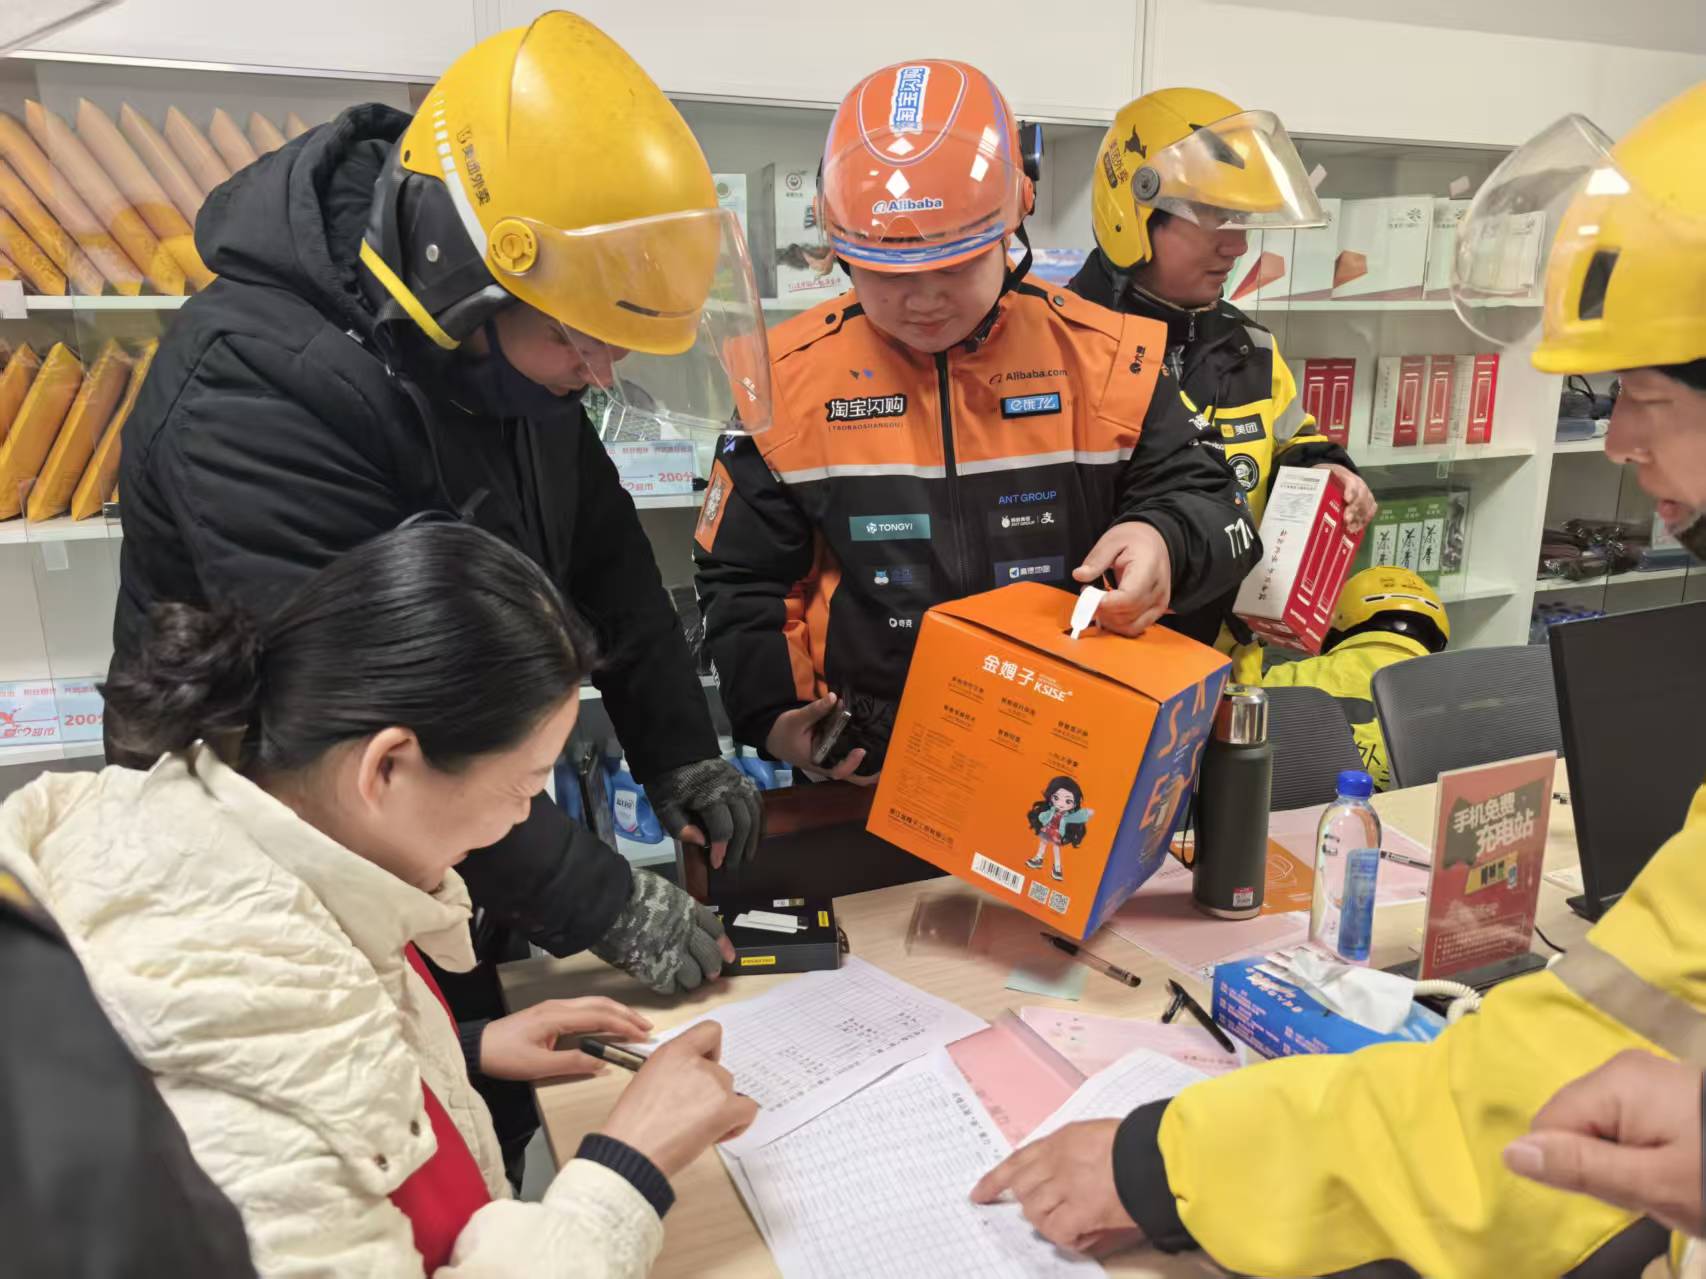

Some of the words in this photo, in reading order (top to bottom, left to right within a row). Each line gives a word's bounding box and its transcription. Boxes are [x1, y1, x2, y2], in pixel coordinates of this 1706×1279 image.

[888, 198, 942, 211] Alibaba
[1006, 369, 1068, 381] Alibaba.com
[830, 397, 904, 418] 淘宝闪购
[998, 495, 1019, 505] ANT
[1020, 490, 1057, 503] GROUP
[879, 523, 913, 532] TONGYI
[982, 655, 1035, 686] 金嫂子
[1034, 682, 1065, 702] KSISE
[1453, 792, 1516, 833] 手机免费
[1476, 808, 1535, 856] 充电站
